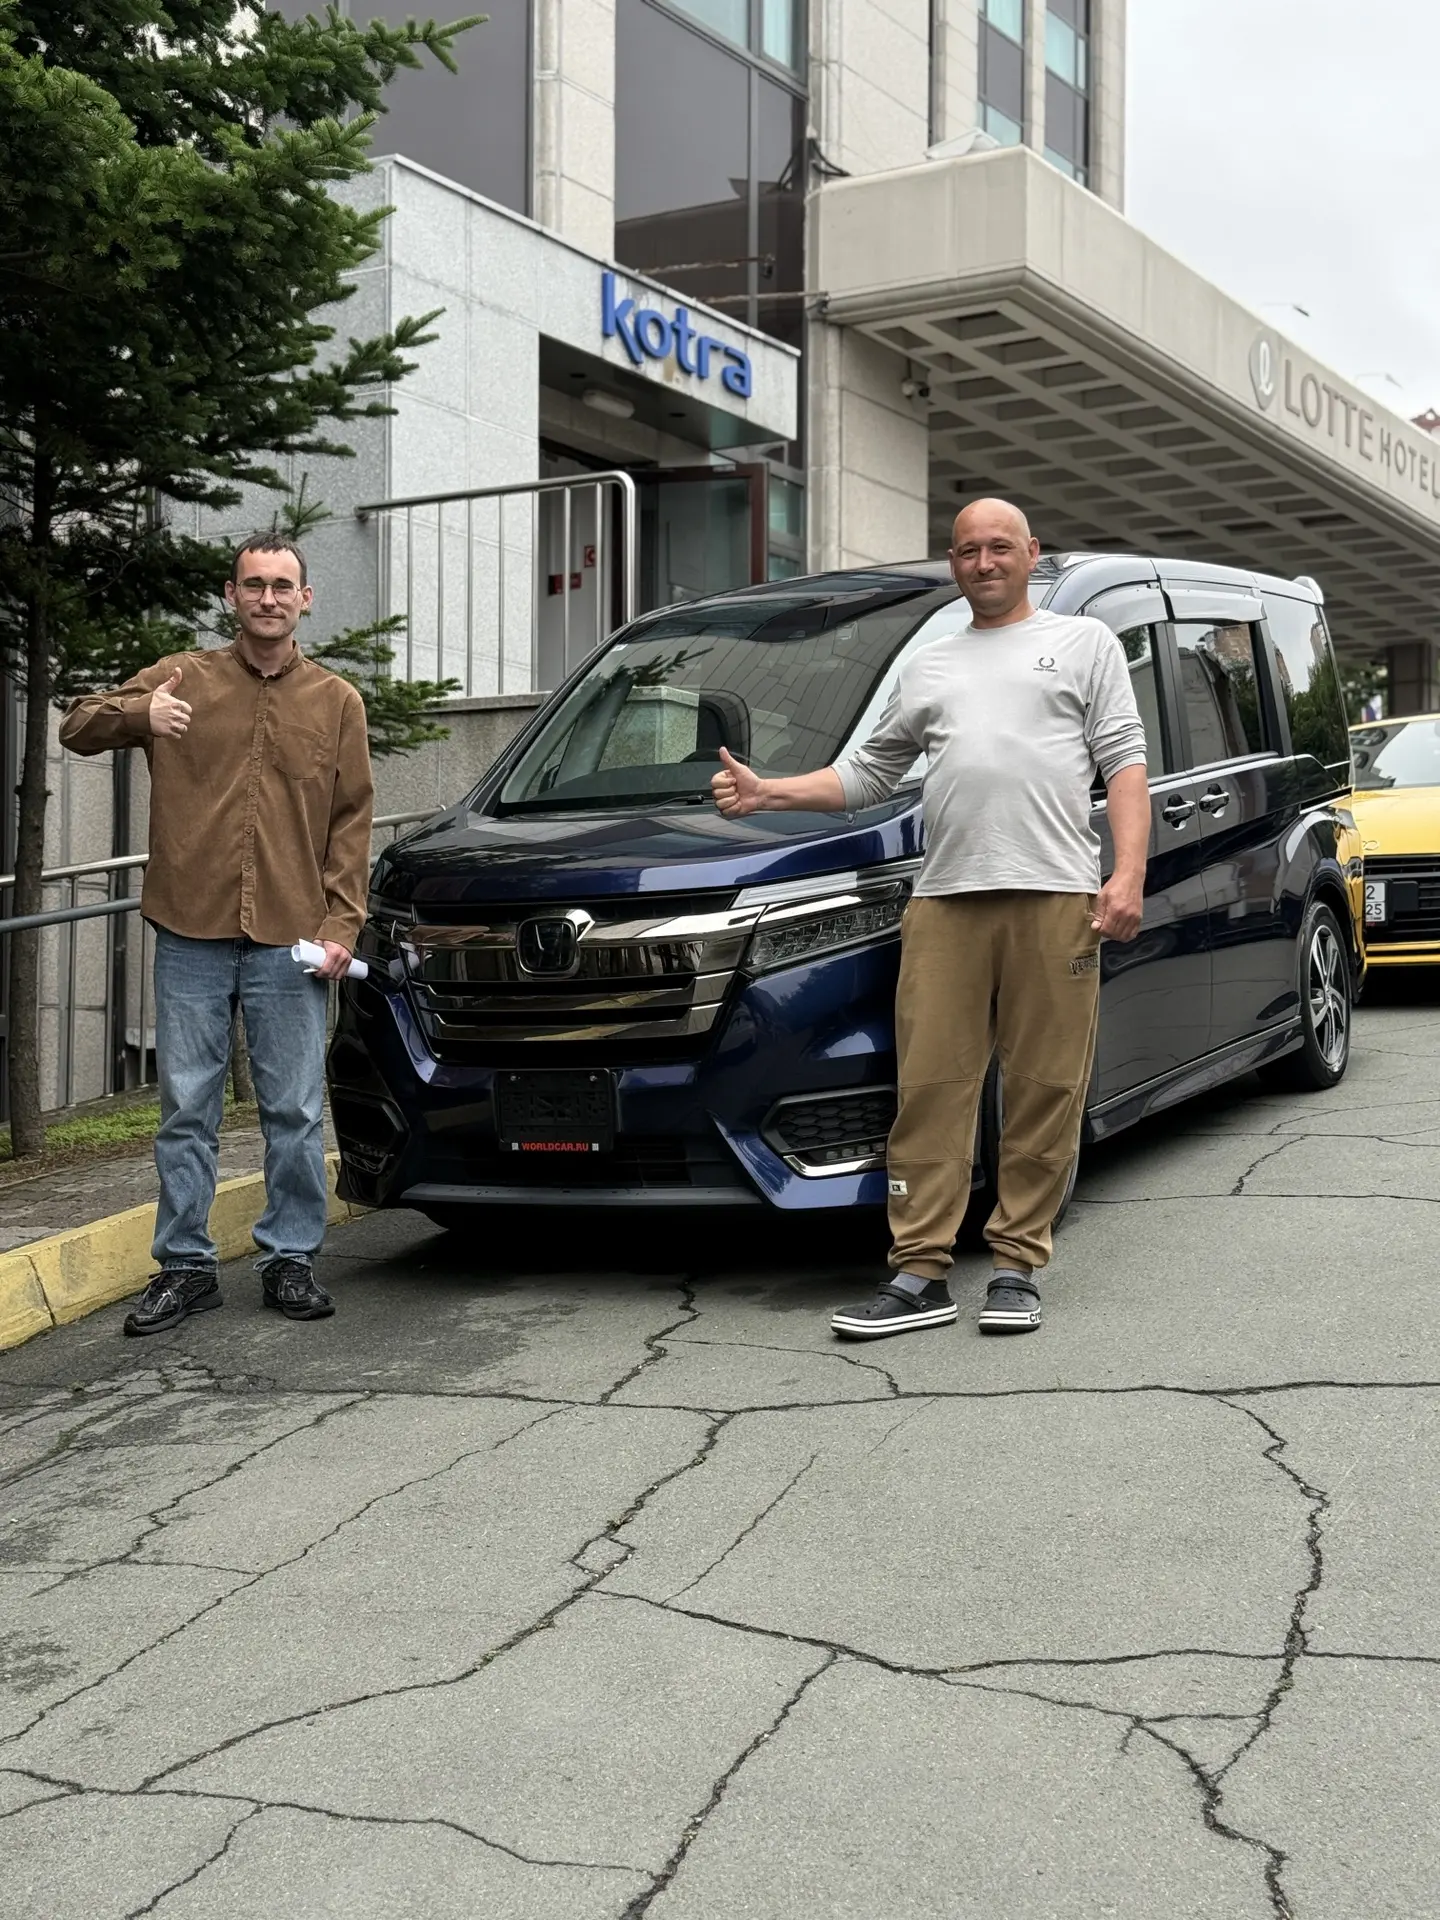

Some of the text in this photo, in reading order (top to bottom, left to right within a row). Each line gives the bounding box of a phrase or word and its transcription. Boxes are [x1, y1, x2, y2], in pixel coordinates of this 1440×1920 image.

[602, 270, 752, 398] kotra
[1284, 358, 1440, 499] LOTTE HOTEL
[521, 1143, 588, 1151] WORLDCAR.RU
